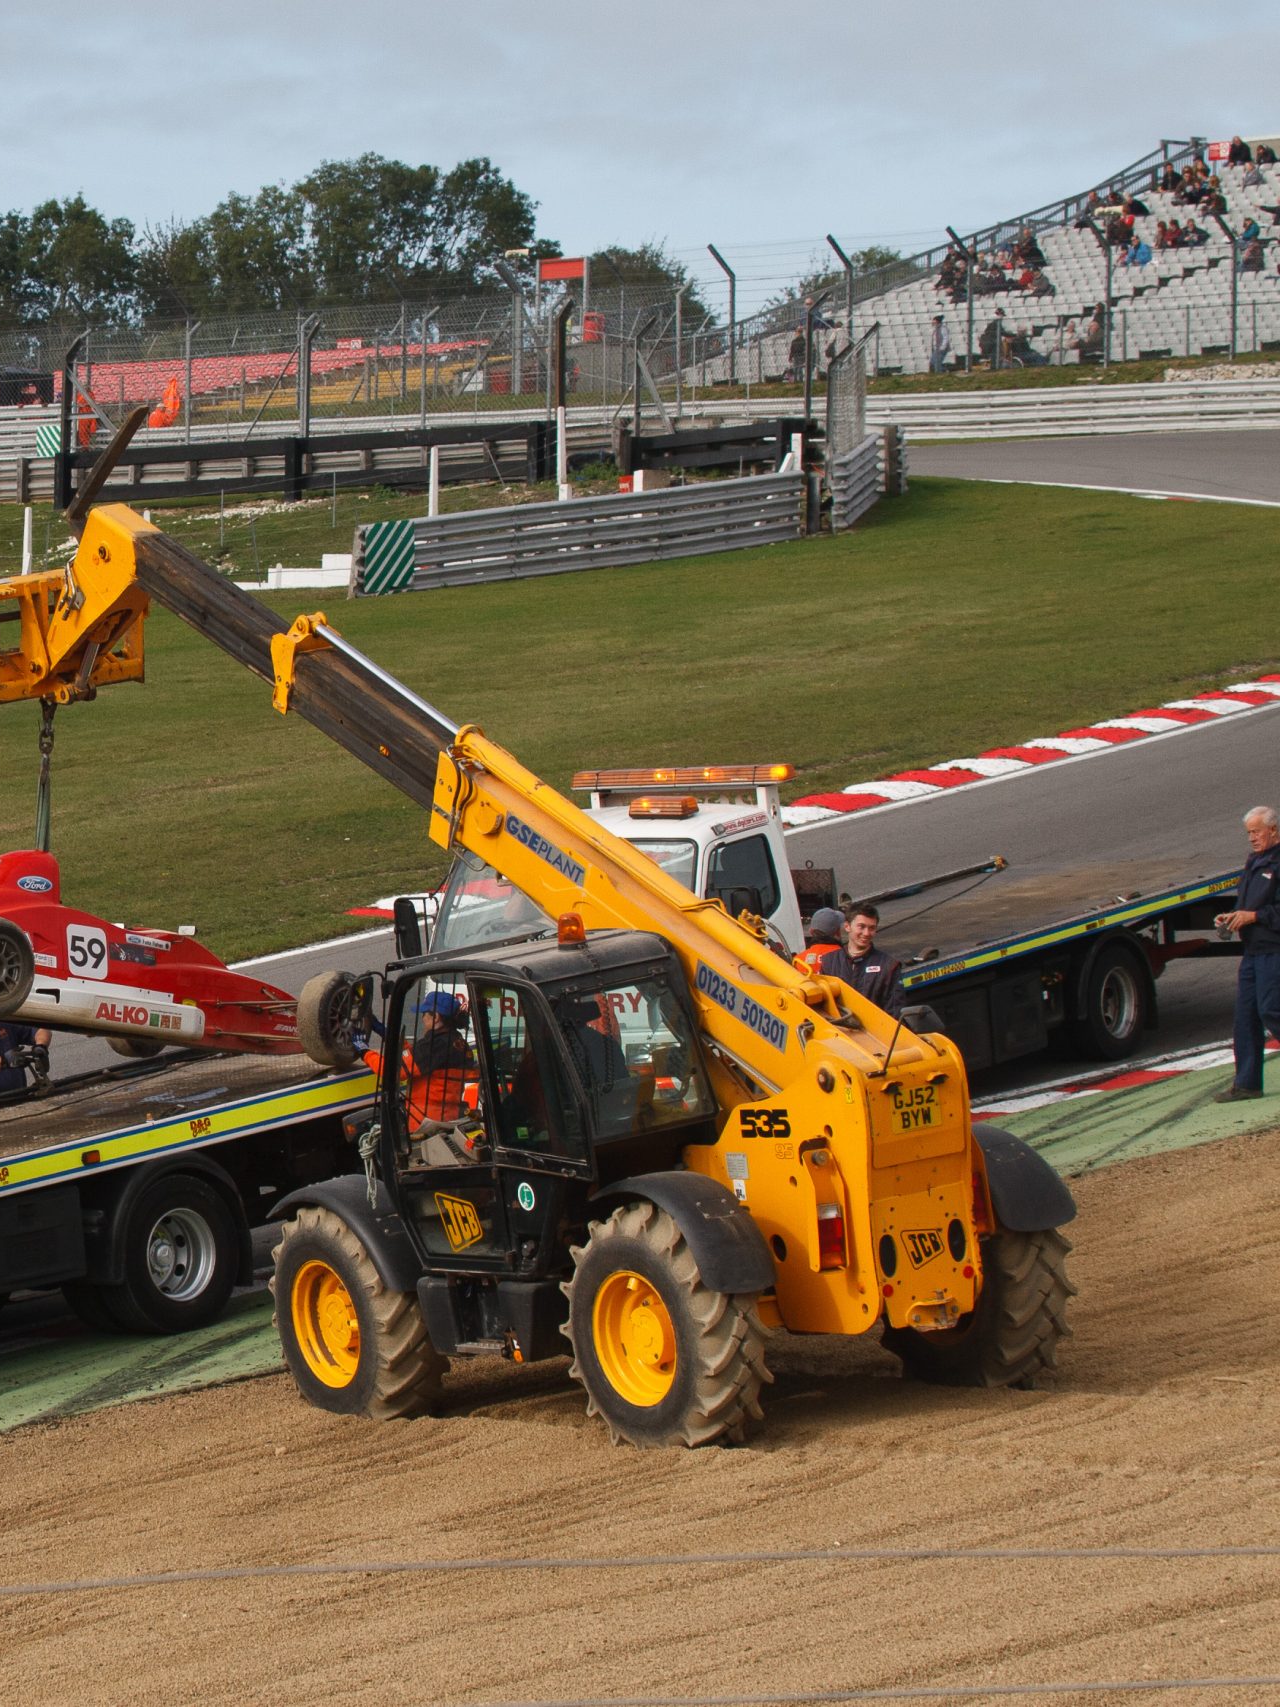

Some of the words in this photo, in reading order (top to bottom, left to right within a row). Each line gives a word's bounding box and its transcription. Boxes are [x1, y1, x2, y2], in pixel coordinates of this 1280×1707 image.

[70, 935, 106, 969] 59
[95, 1002, 149, 1025] AL-KO
[698, 965, 736, 1011] 01233
[741, 997, 785, 1048] 501301
[893, 1086, 935, 1109] GJ52
[190, 1117, 211, 1131] D&G
[740, 1109, 791, 1138] 535
[901, 1107, 932, 1129] BYW
[775, 1143, 794, 1159] 95
[443, 1199, 480, 1246] JCB
[908, 1232, 941, 1264] JCB
